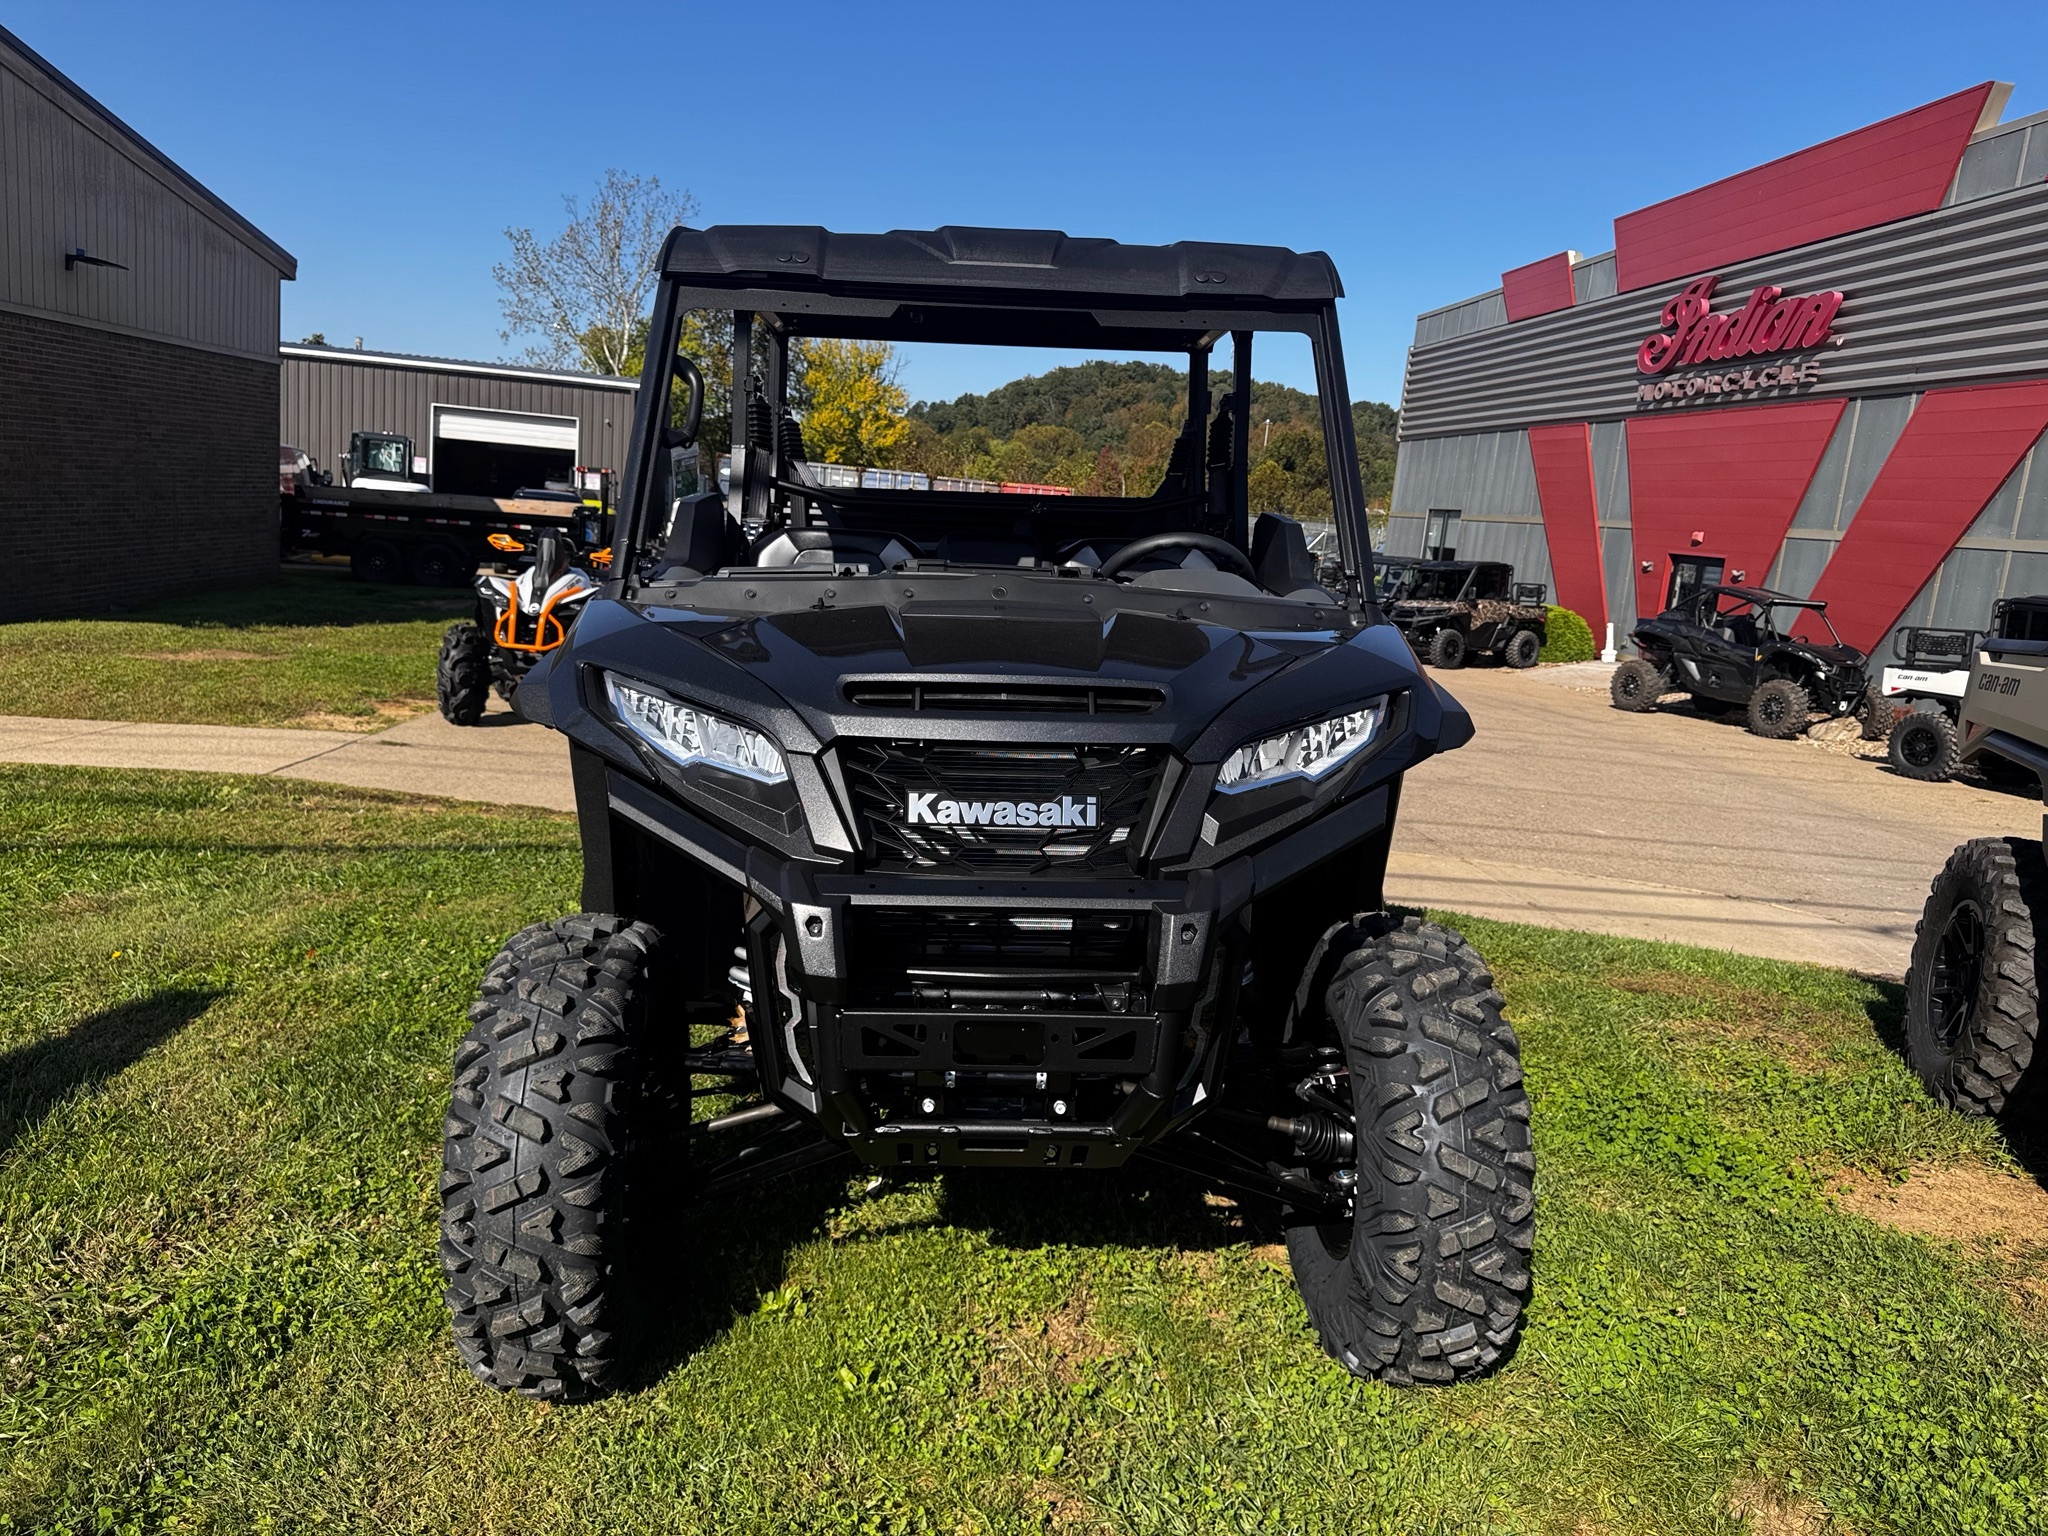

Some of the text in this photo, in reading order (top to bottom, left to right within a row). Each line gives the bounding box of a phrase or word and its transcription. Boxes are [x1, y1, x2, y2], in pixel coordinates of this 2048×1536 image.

[1637, 275, 1844, 375] Indian
[1636, 361, 1820, 402] MOTORCYCLE
[1978, 673, 2021, 697] can-am
[908, 792, 1097, 827] Kawasaki
